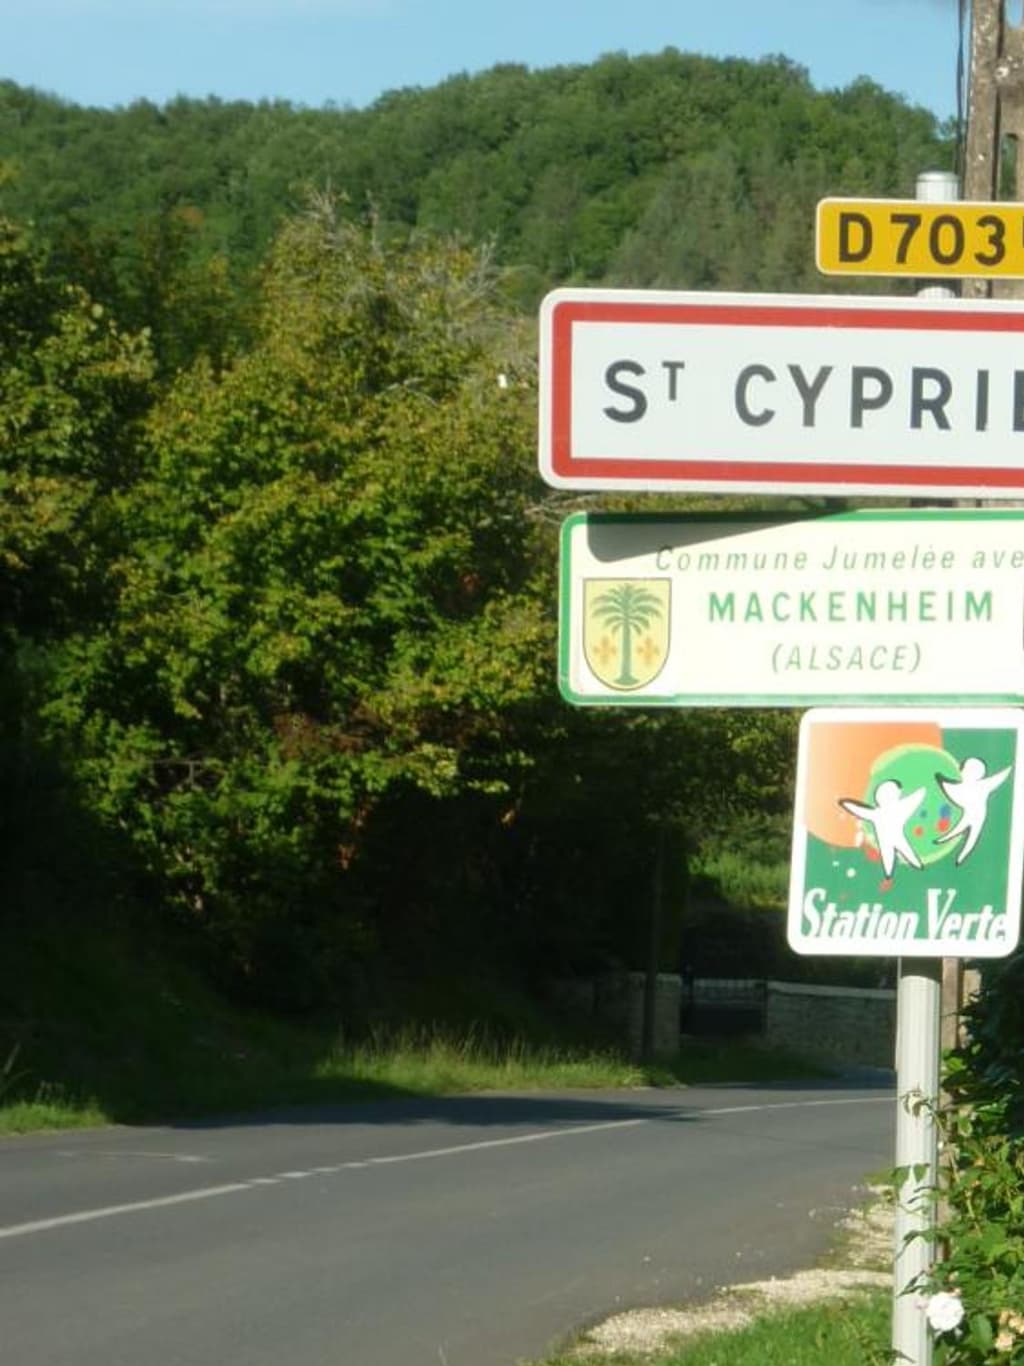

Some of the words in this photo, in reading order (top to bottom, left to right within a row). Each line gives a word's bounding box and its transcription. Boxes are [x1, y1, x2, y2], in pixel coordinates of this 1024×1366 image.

[656, 546, 807, 571] Commune
[823, 545, 956, 570] Jumelée
[708, 591, 994, 622] MACKENHEIM
[772, 643, 922, 672] (ALSACE)
[801, 888, 919, 939] Station
[927, 888, 1009, 940] Verte
